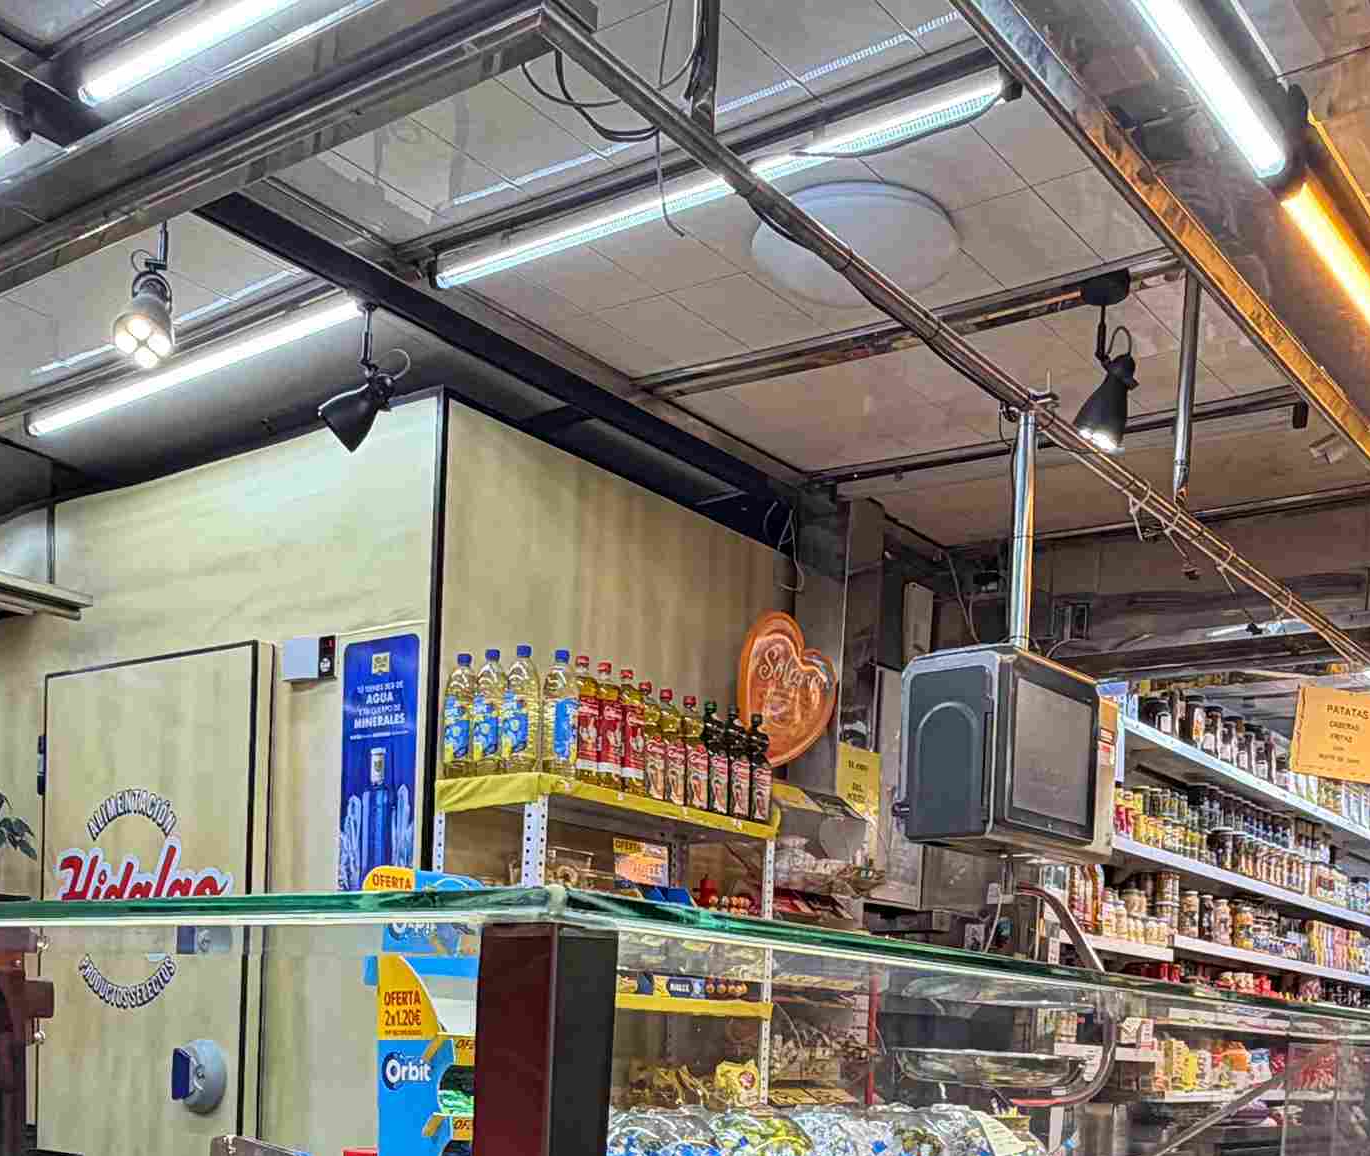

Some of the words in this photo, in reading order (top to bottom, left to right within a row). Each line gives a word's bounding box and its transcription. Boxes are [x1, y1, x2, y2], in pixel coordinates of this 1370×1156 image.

[366, 691, 394, 704] AGUA
[354, 713, 406, 729] MINERALES
[86, 789, 177, 842] ALIMENTACIÓN
[372, 872, 412, 891] OFERTA
[79, 953, 131, 1009] PRODUCTOS
[129, 955, 177, 1008] SELECTOS
[384, 990, 422, 1006] OFERTA
[385, 1057, 431, 1083] Orbit
